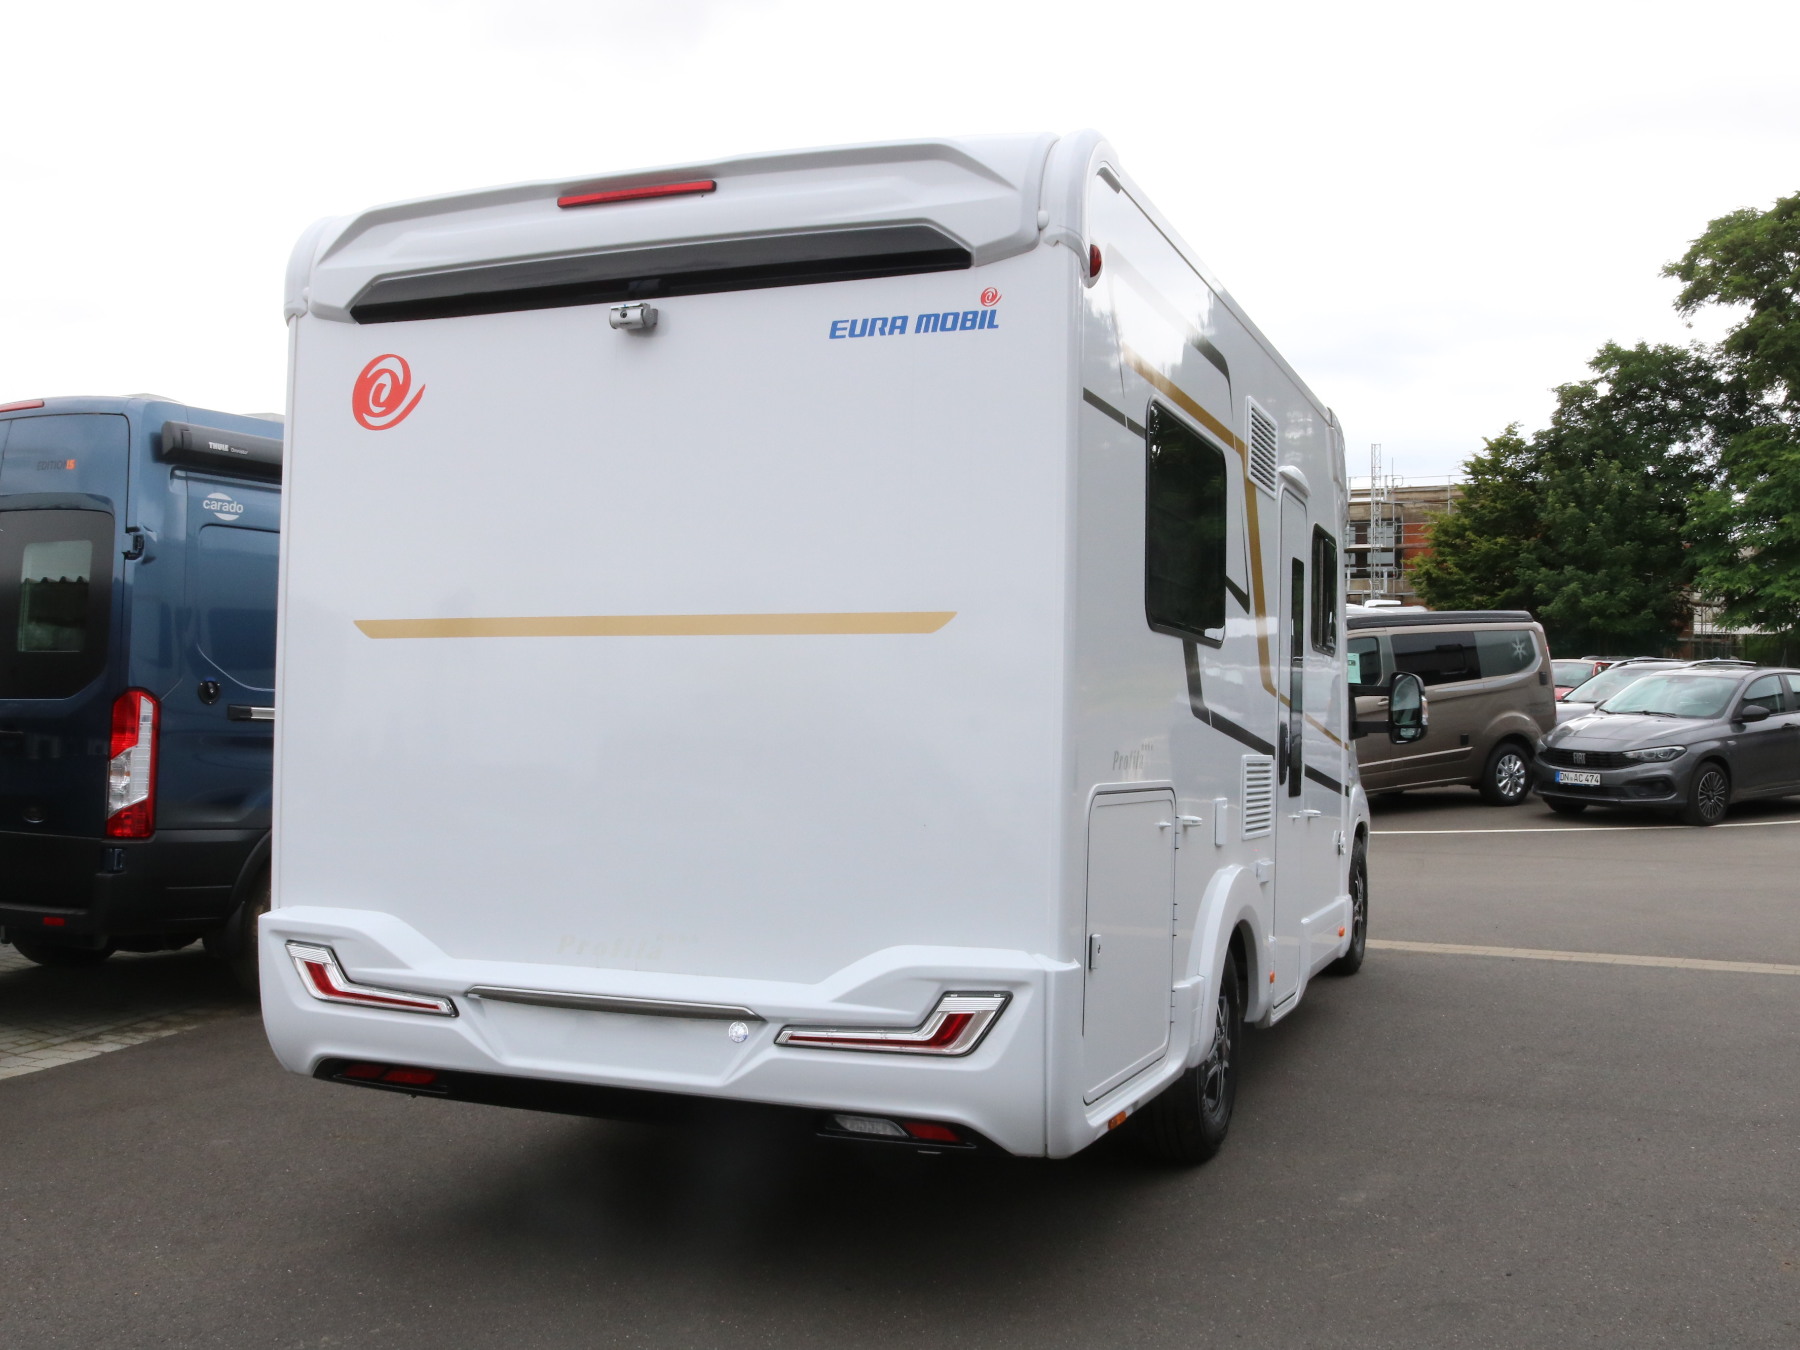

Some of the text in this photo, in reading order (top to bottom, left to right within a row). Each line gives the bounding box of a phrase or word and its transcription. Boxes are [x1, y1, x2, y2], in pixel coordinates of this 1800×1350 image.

[829, 309, 999, 339] EURA MOBIL
[208, 441, 229, 452] THULE
[203, 499, 244, 513] carado
[1573, 774, 1583, 783] AC
[1585, 774, 1600, 784] 474
